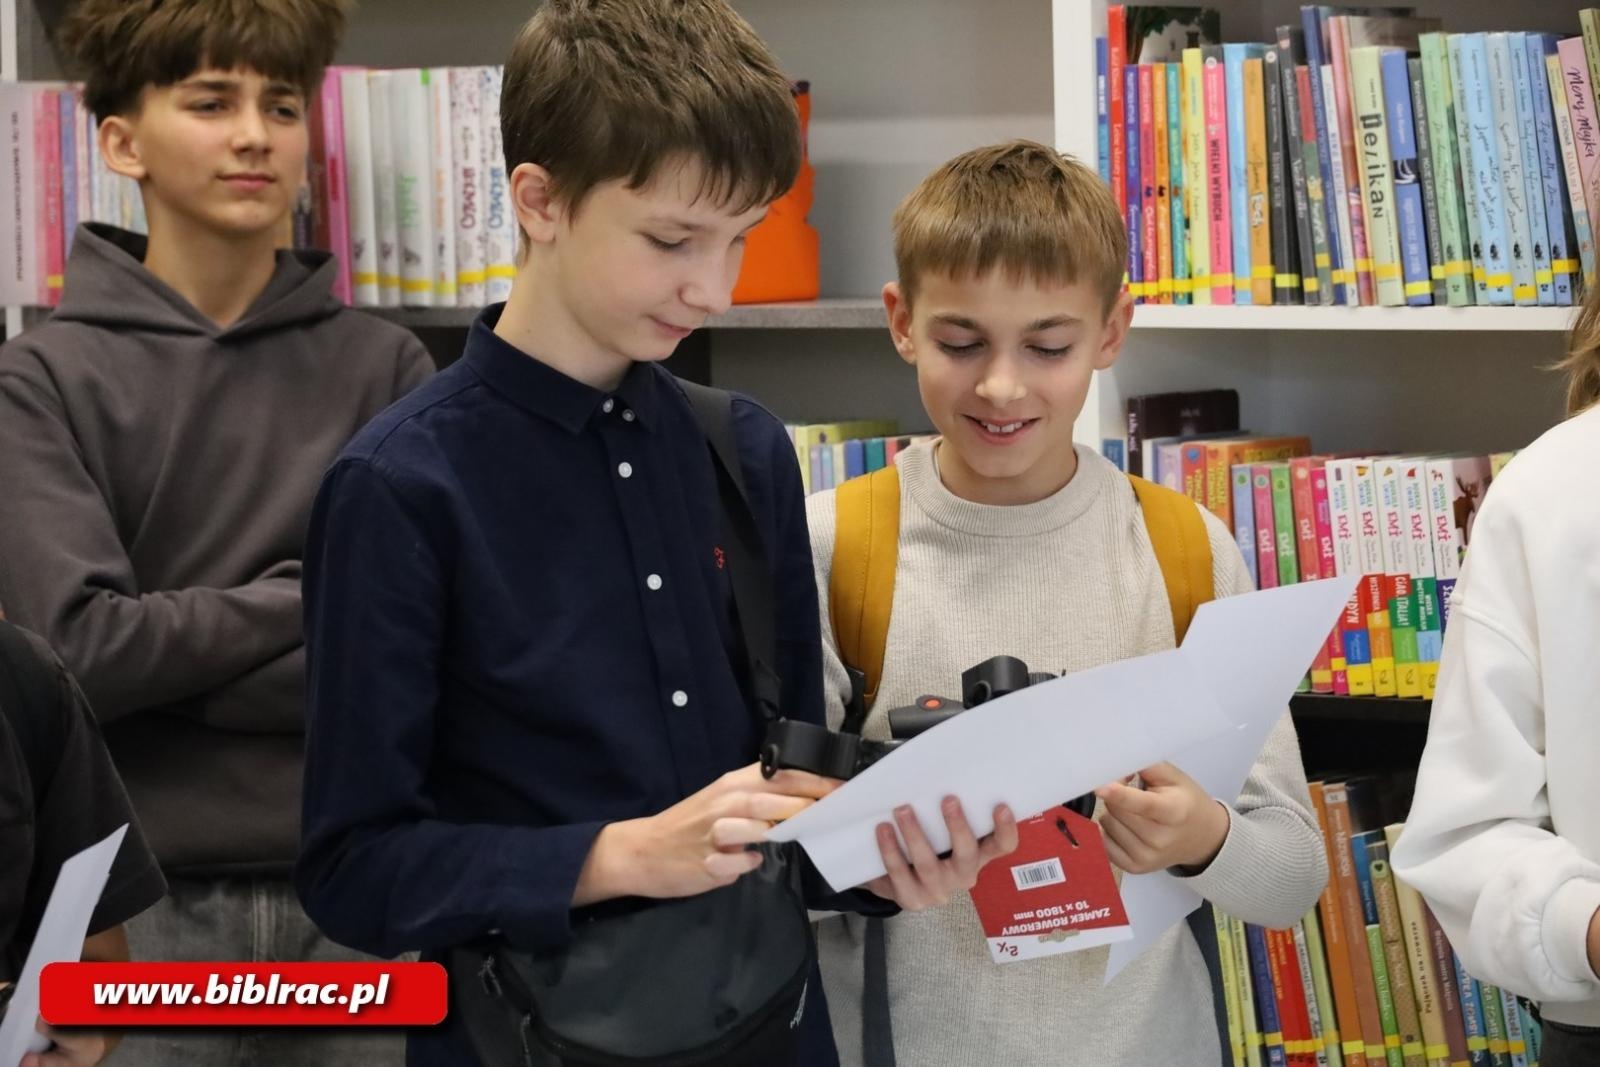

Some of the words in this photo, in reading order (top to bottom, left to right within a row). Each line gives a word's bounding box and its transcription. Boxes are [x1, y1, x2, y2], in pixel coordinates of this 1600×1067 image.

[1567, 68, 1585, 111] Mery
[1577, 117, 1594, 157] Majka
[1210, 139, 1222, 174] WIELKI
[1212, 176, 1223, 222] WYBUCH
[1036, 905, 1065, 918] 1800
[1076, 900, 1090, 910] 10
[1013, 911, 1034, 920] mm
[1071, 907, 1110, 924] ZAMEK
[1002, 916, 1068, 936] ROWEROWY
